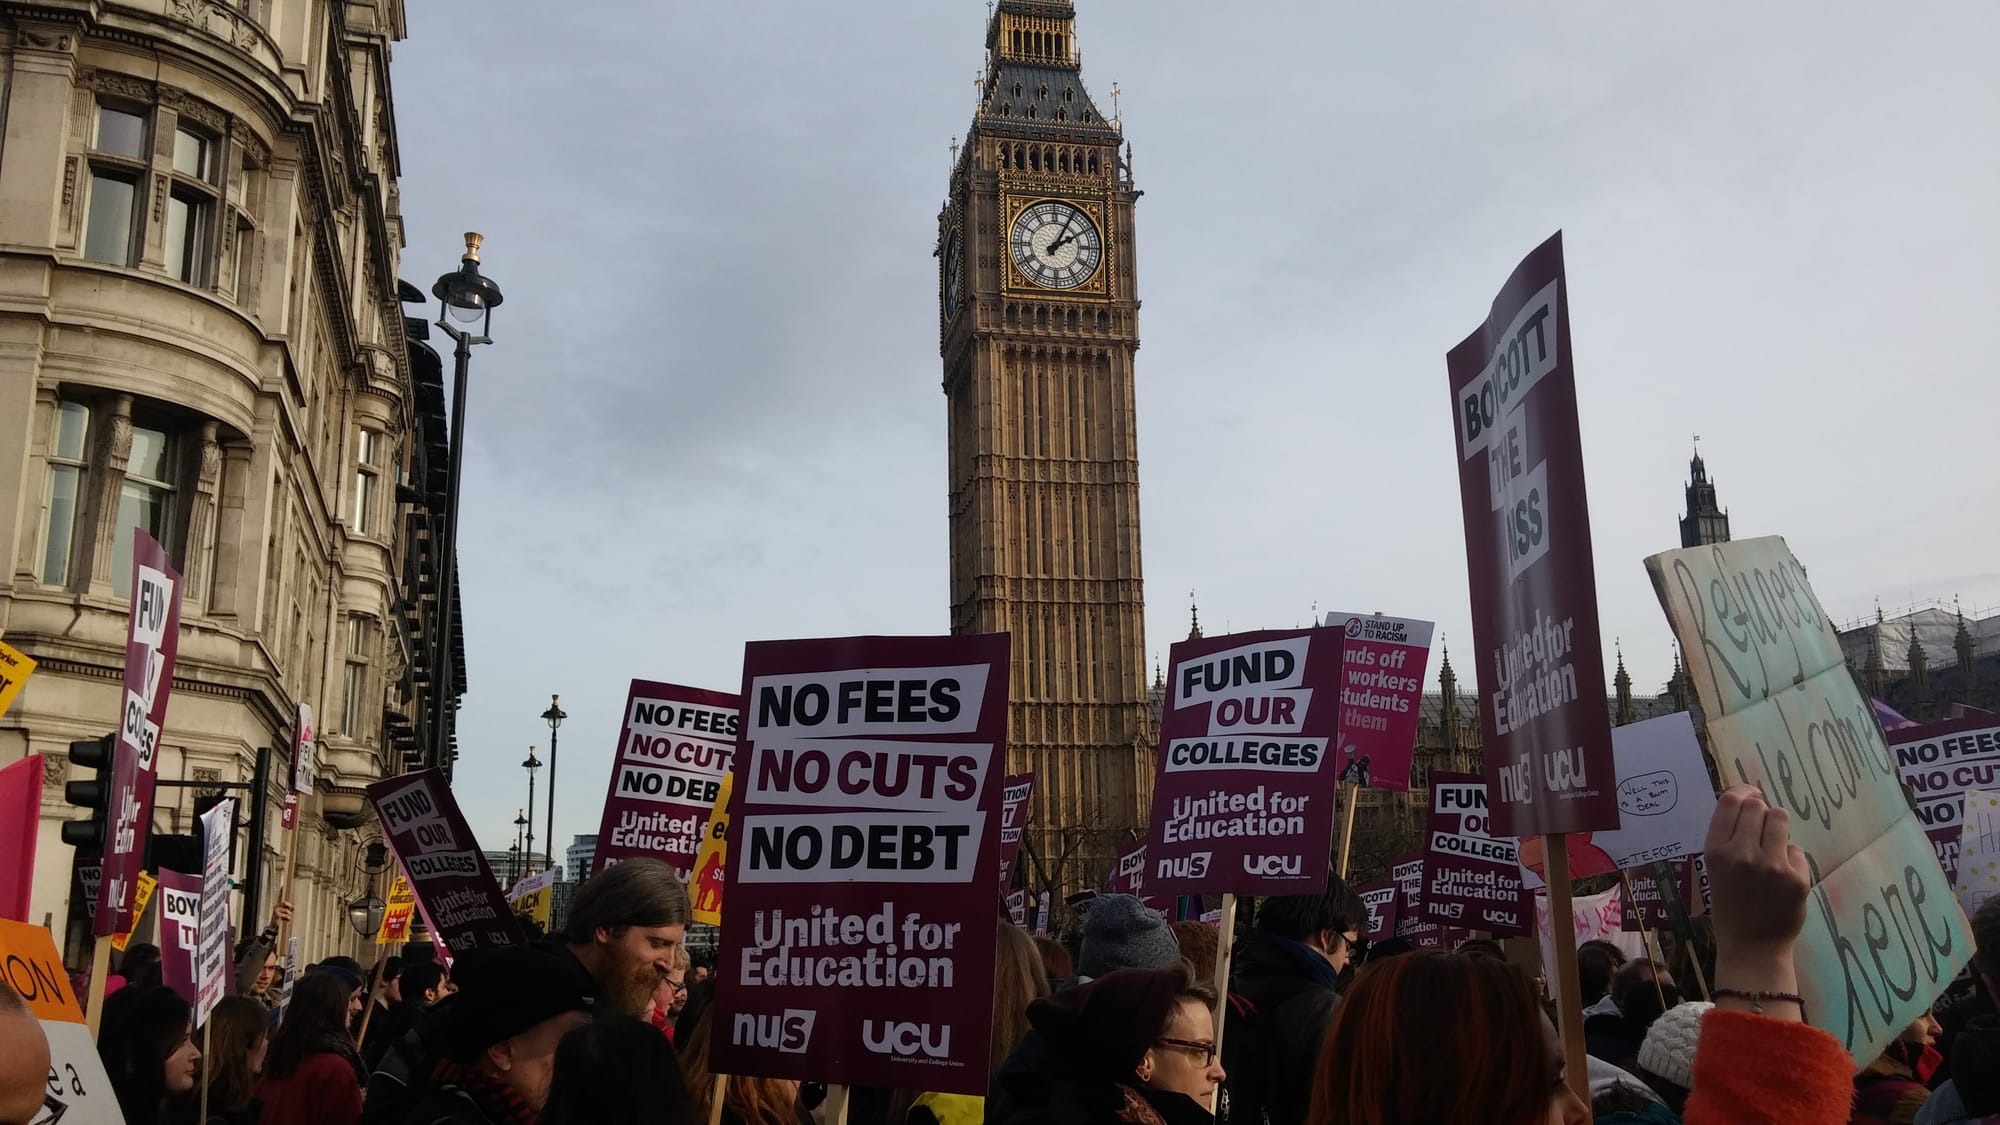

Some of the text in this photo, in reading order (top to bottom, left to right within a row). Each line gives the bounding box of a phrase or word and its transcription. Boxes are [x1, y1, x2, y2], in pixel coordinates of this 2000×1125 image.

[1464, 303, 1548, 443] BOYCOTT
[1491, 425, 1522, 493] THE
[1507, 488, 1544, 565] NSS
[1364, 620, 1405, 633] STAND UP
[1364, 629, 1408, 643] TO RACISM
[1380, 650, 1406, 669] off
[1495, 608, 1574, 692] United for
[1183, 649, 1294, 699] FUND
[1348, 670, 1418, 693] workers
[758, 678, 961, 727] NO FEES
[1493, 659, 1577, 736] Education
[634, 702, 675, 726] NO
[1216, 696, 1295, 727] OUR
[1344, 709, 1388, 731] them
[630, 733, 672, 758] NO
[1171, 741, 1318, 767] COLLEGES
[1896, 744, 1939, 767] NO
[622, 771, 663, 795] NO
[757, 750, 978, 801] NO CUTS
[1499, 746, 1587, 803] nus ucu
[1906, 770, 1949, 793] NO
[382, 789, 432, 828] FUND
[1172, 786, 1309, 823] United for
[1914, 803, 1954, 825] NO
[621, 810, 697, 834] United
[1163, 810, 1305, 843] Education
[416, 823, 453, 847] OUR
[750, 825, 822, 870] NO
[830, 825, 970, 870] DEBT
[410, 855, 477, 876] COLLEGES
[1157, 852, 1212, 879] nus
[1243, 855, 1301, 876] ucu
[1403, 879, 1420, 894] THE
[1437, 868, 1520, 889] United for
[431, 885, 474, 914] United
[472, 890, 489, 906] for
[1432, 880, 1518, 902] Education
[435, 905, 496, 929] Education
[1428, 902, 1517, 924] nus ucu
[754, 901, 961, 950] United for
[1396, 923, 1437, 937] Education
[450, 931, 478, 950] nus
[1420, 937, 1437, 946] ucu
[740, 943, 953, 988] Education
[732, 1008, 950, 1057] nus ucu
[891, 1056, 917, 1064] University
